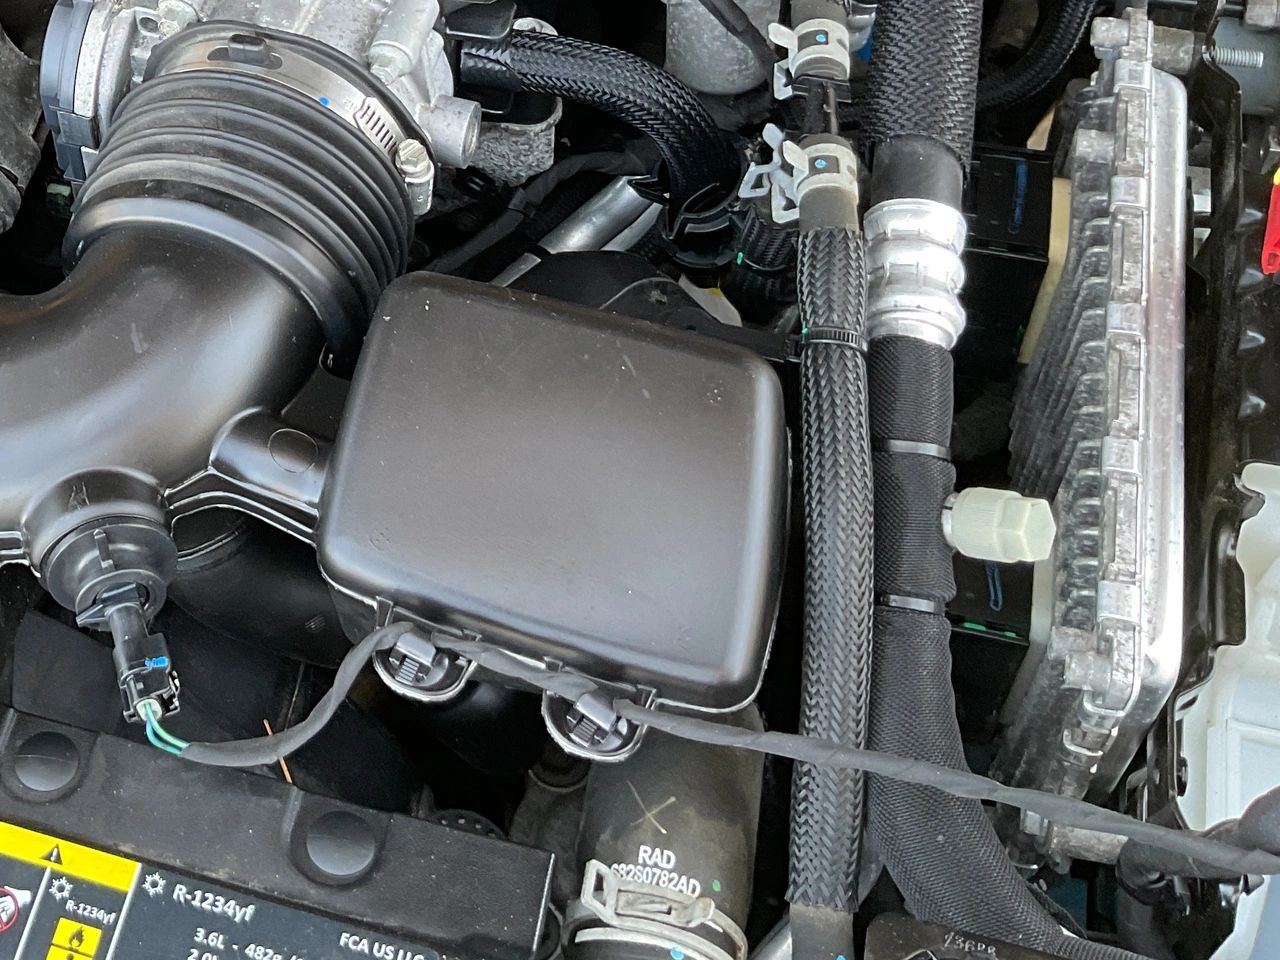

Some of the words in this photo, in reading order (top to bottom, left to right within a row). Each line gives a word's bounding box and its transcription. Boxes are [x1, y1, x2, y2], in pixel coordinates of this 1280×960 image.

[638, 844, 676, 869] RAD
[65, 899, 117, 925] R-1234yf
[172, 883, 256, 923] R-1234yf
[193, 927, 225, 950] 3.6L
[339, 932, 369, 954] FCA
[372, 942, 395, 960] US
